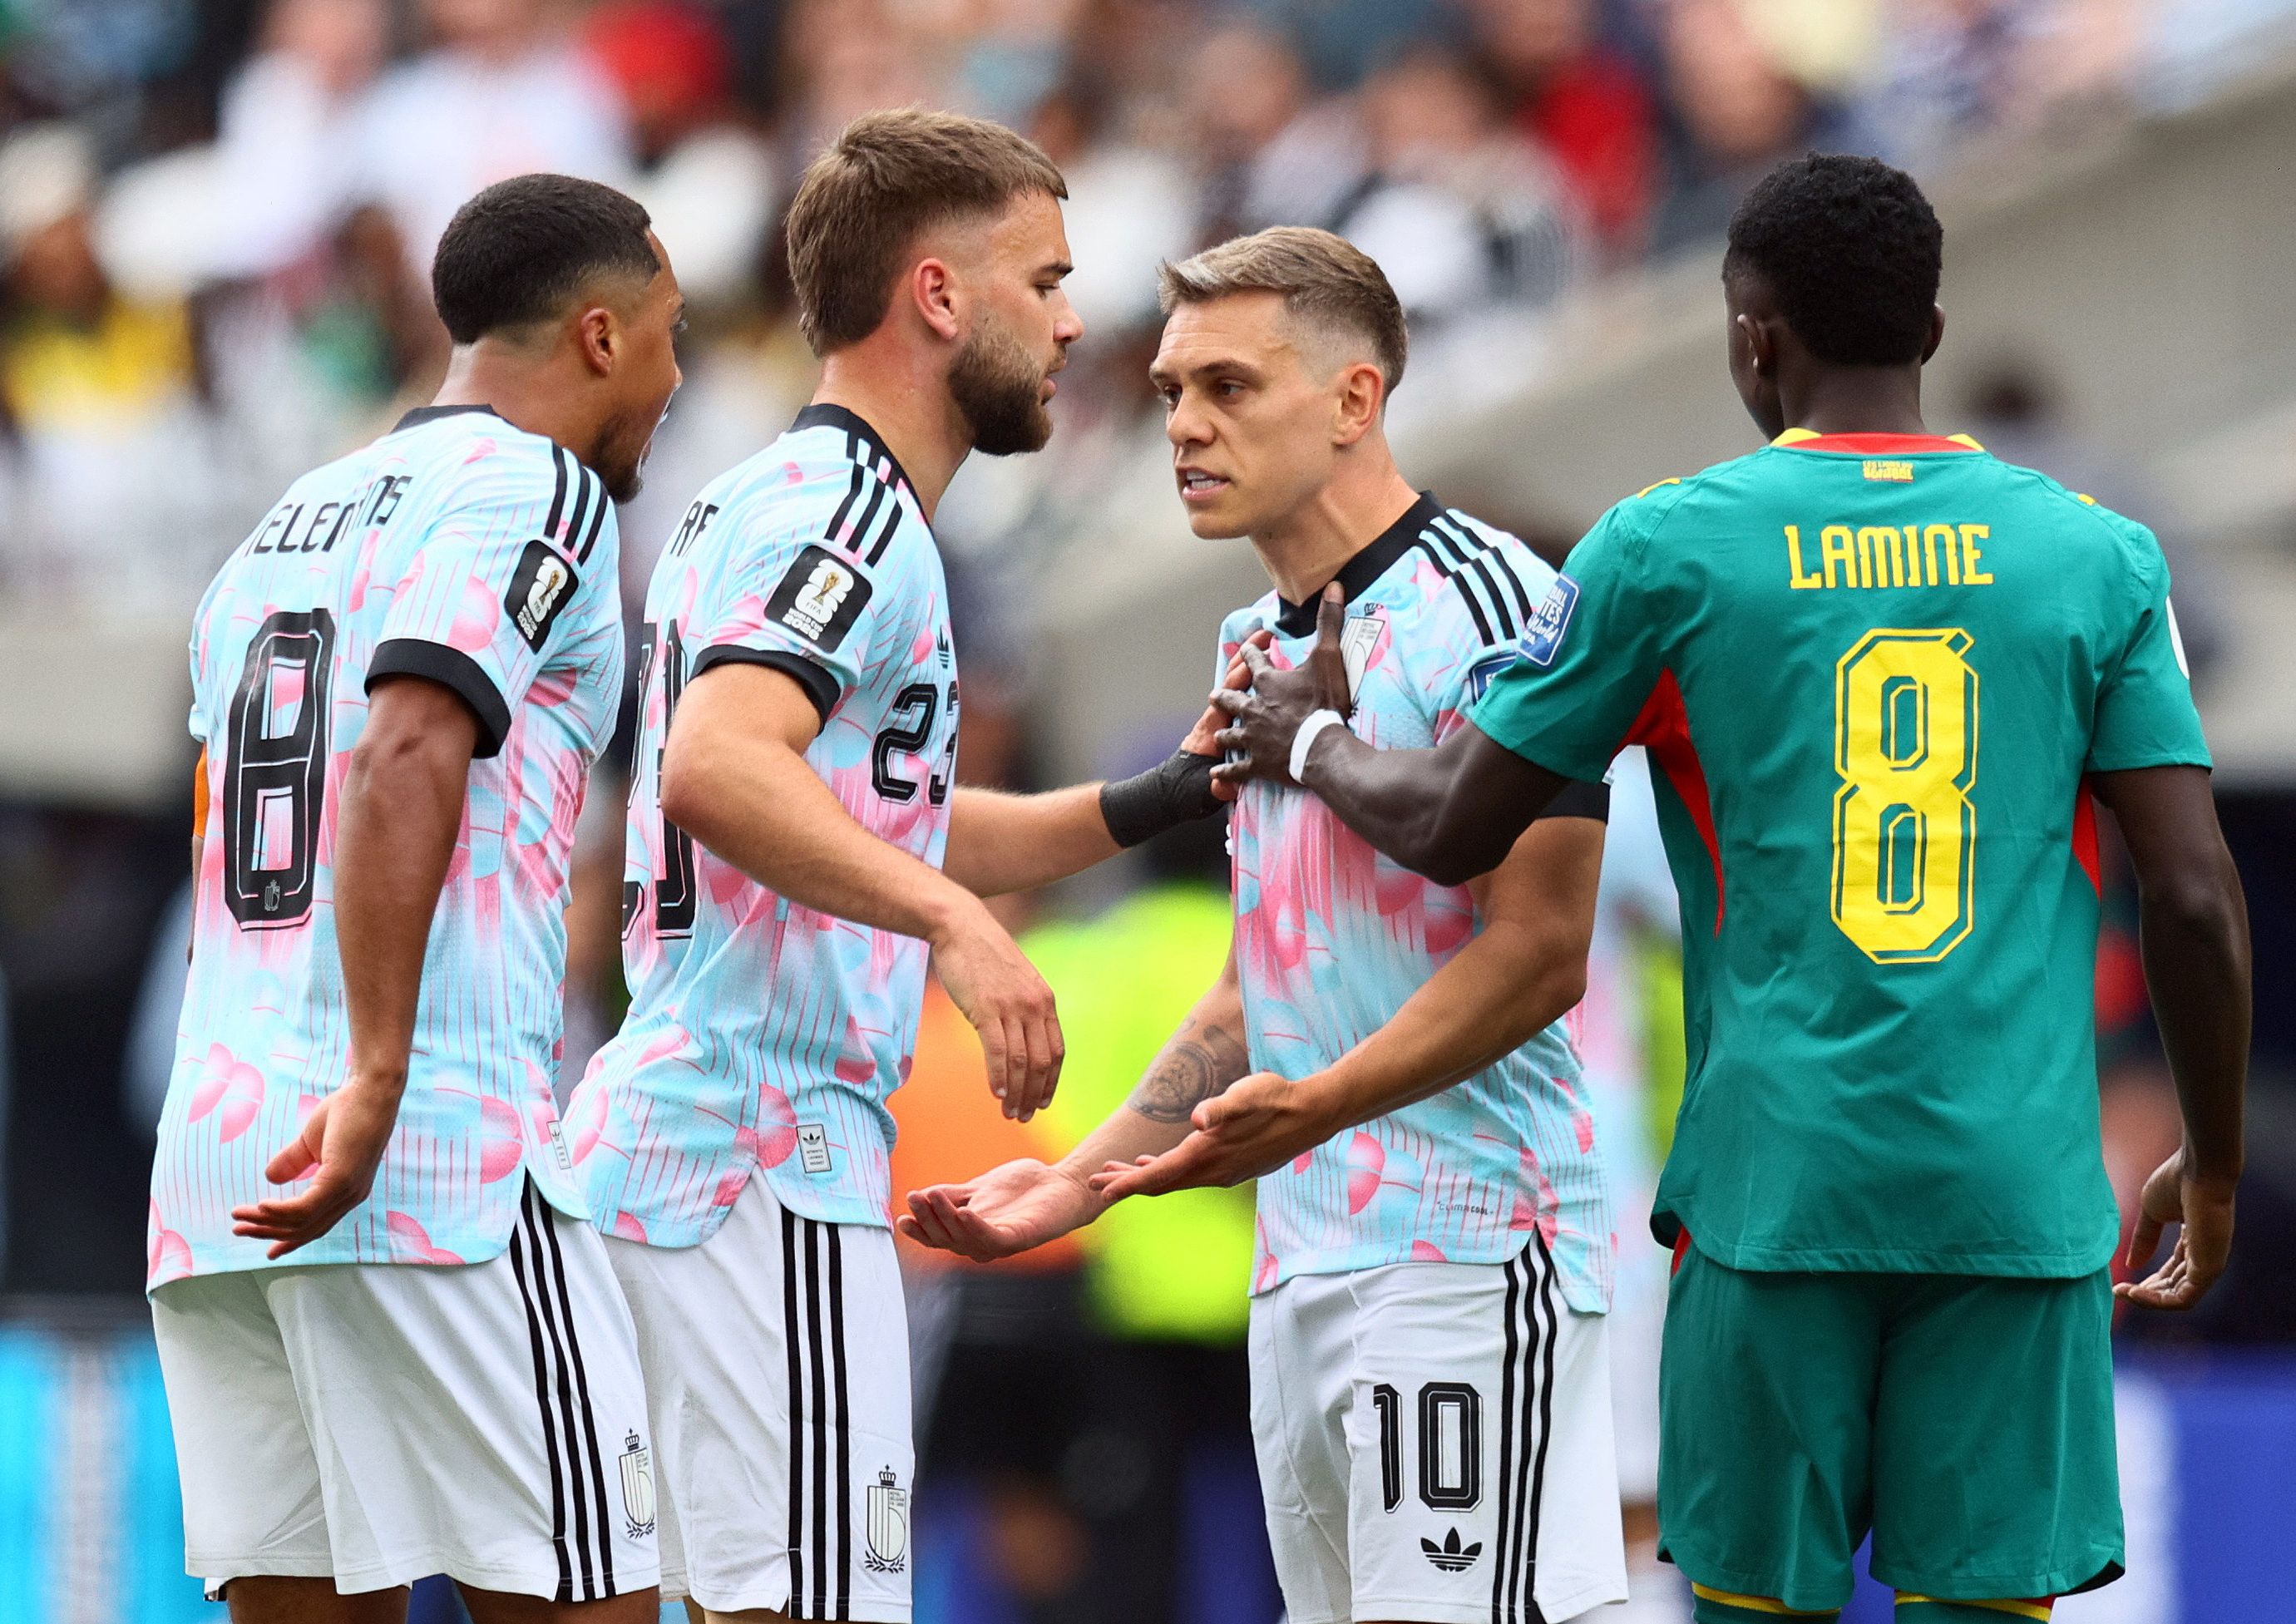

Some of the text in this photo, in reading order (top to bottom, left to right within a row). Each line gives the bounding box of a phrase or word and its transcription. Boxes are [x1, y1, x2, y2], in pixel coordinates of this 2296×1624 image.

[806, 601, 822, 615] FIFA
[1785, 525, 1993, 589] LAMINE
[223, 609, 335, 931] 8
[1831, 628, 1979, 965] 8
[1373, 1381, 1484, 1513] 10
